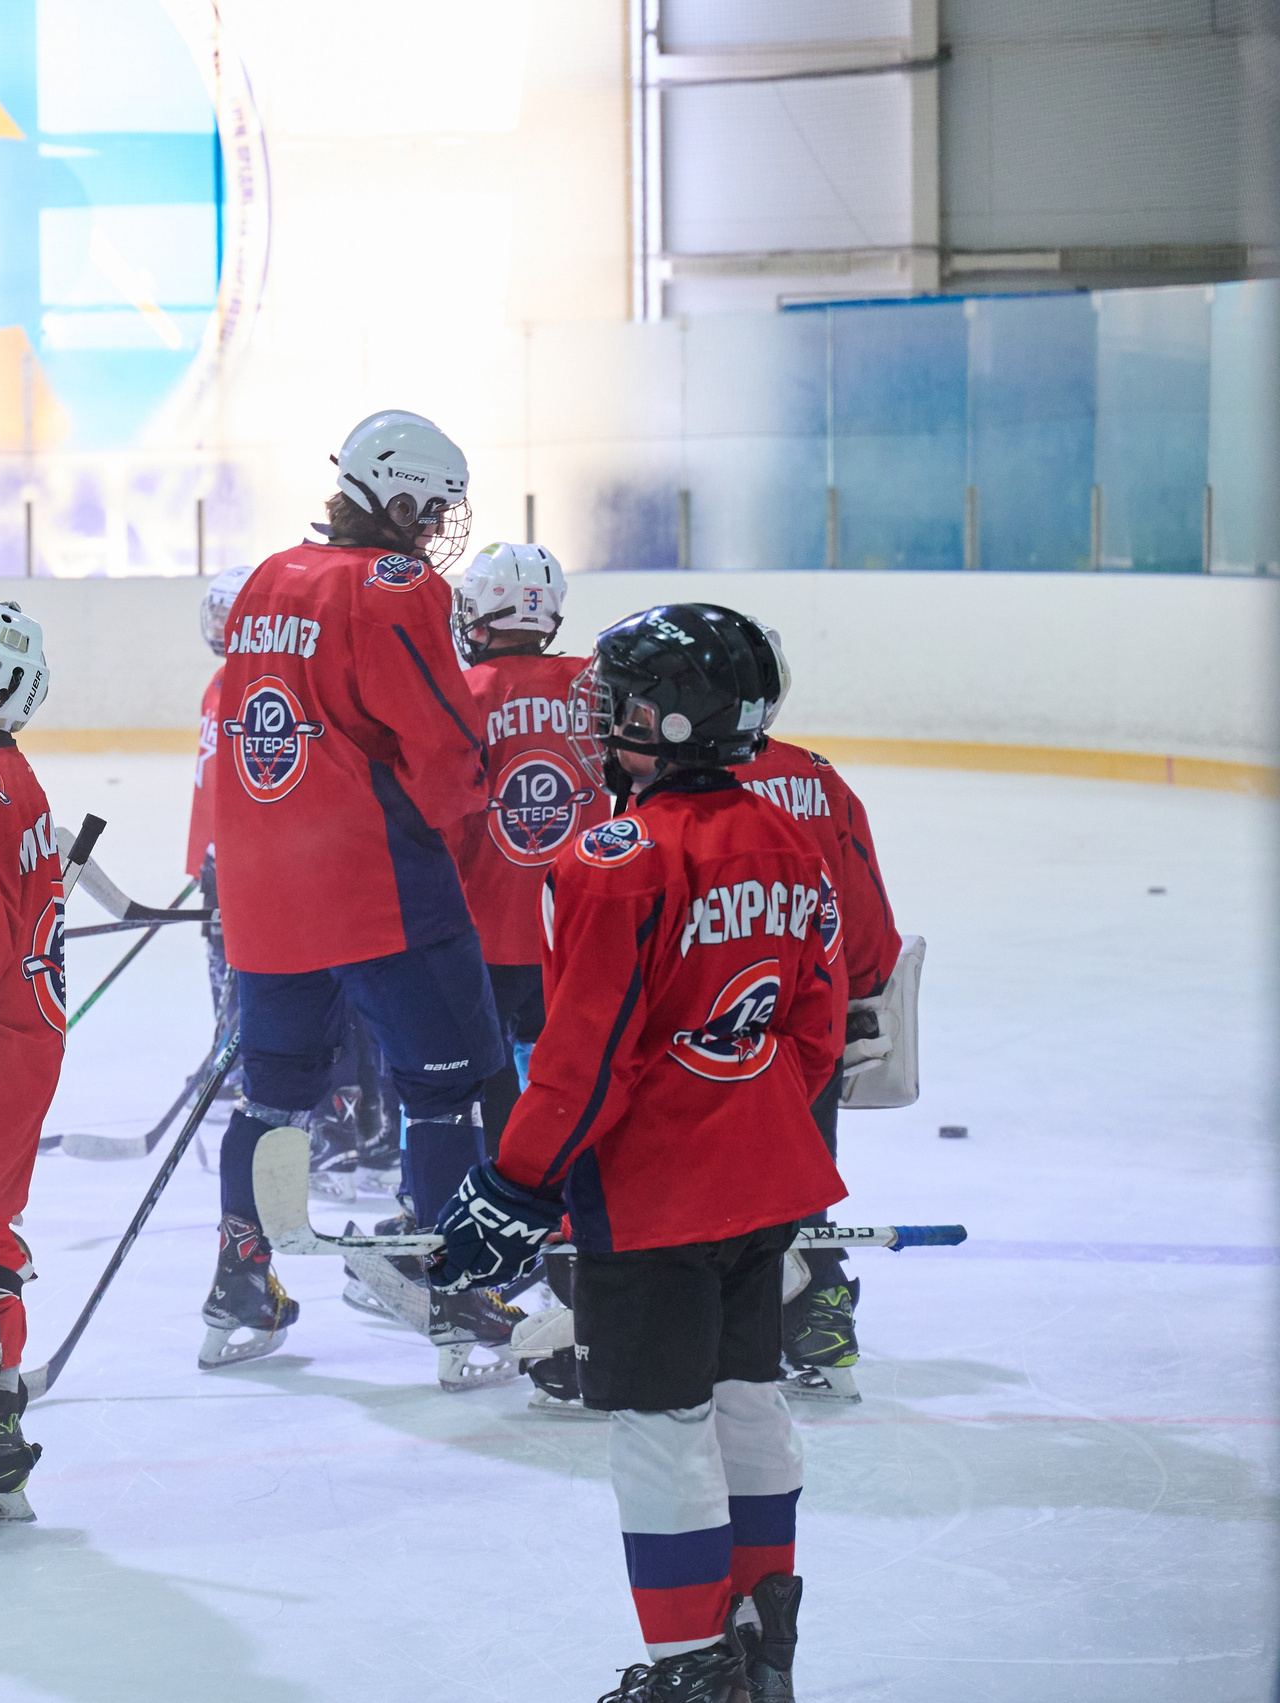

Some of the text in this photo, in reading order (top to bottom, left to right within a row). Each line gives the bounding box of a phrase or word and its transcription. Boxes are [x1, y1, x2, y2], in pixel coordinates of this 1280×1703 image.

[395, 471, 426, 484] CCM
[379, 556, 407, 569] 10
[528, 590, 538, 612] 3
[646, 616, 696, 646] CCM
[23, 670, 43, 715] BAUER
[253, 701, 285, 733] 10
[486, 697, 588, 746] ПЕТРОВ
[245, 737, 296, 754] STEPS
[517, 773, 558, 804] 10
[506, 806, 570, 825] STEPS
[587, 831, 632, 850] STEPS
[423, 1059, 469, 1071] BAUER
[459, 1173, 549, 1245] CCM
